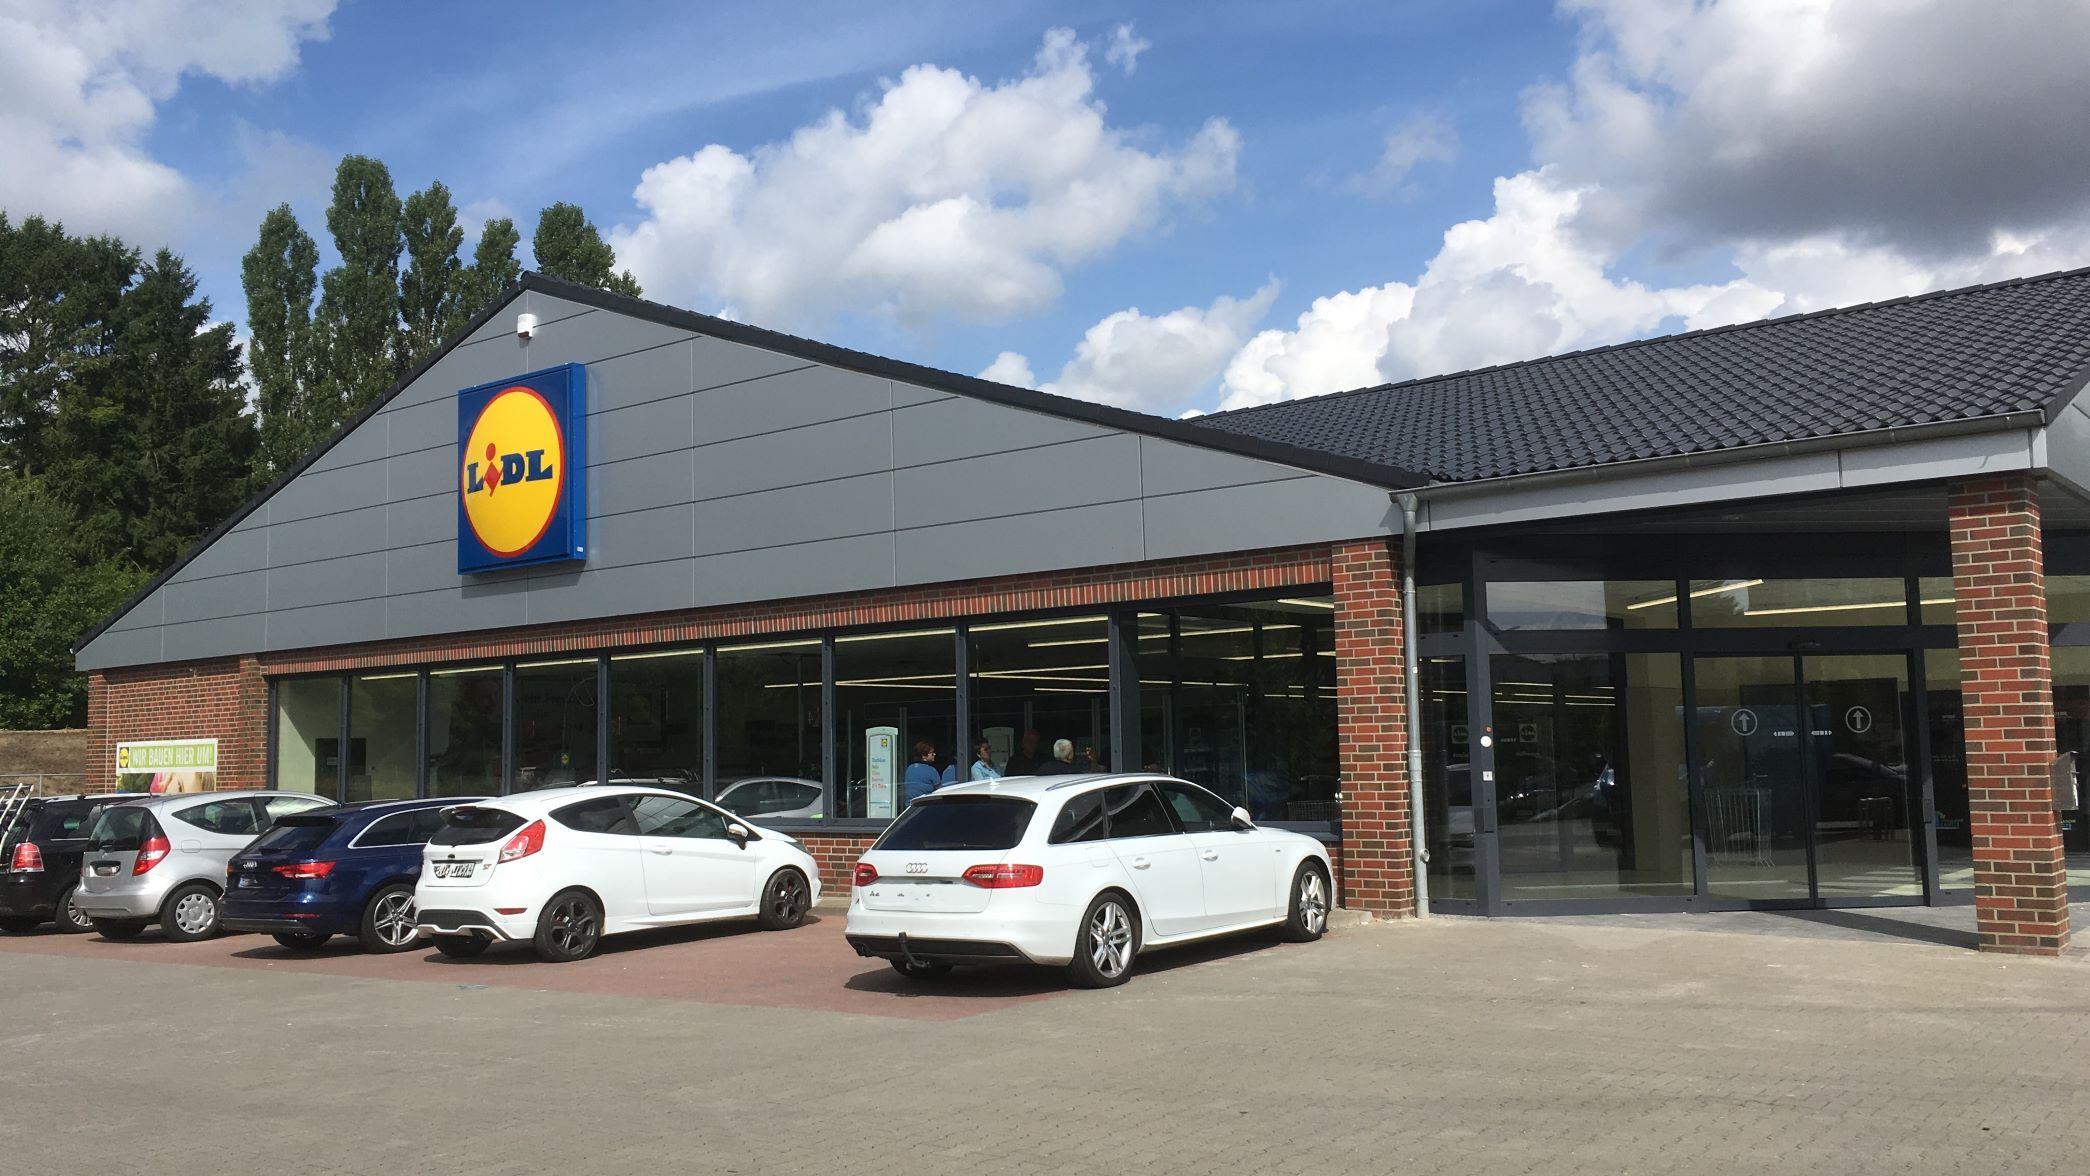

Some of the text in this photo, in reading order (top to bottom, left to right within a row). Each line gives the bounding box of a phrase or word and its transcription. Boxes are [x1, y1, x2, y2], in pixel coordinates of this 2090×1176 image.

[131, 745, 214, 767] WIR BAUEN HIER UM!
